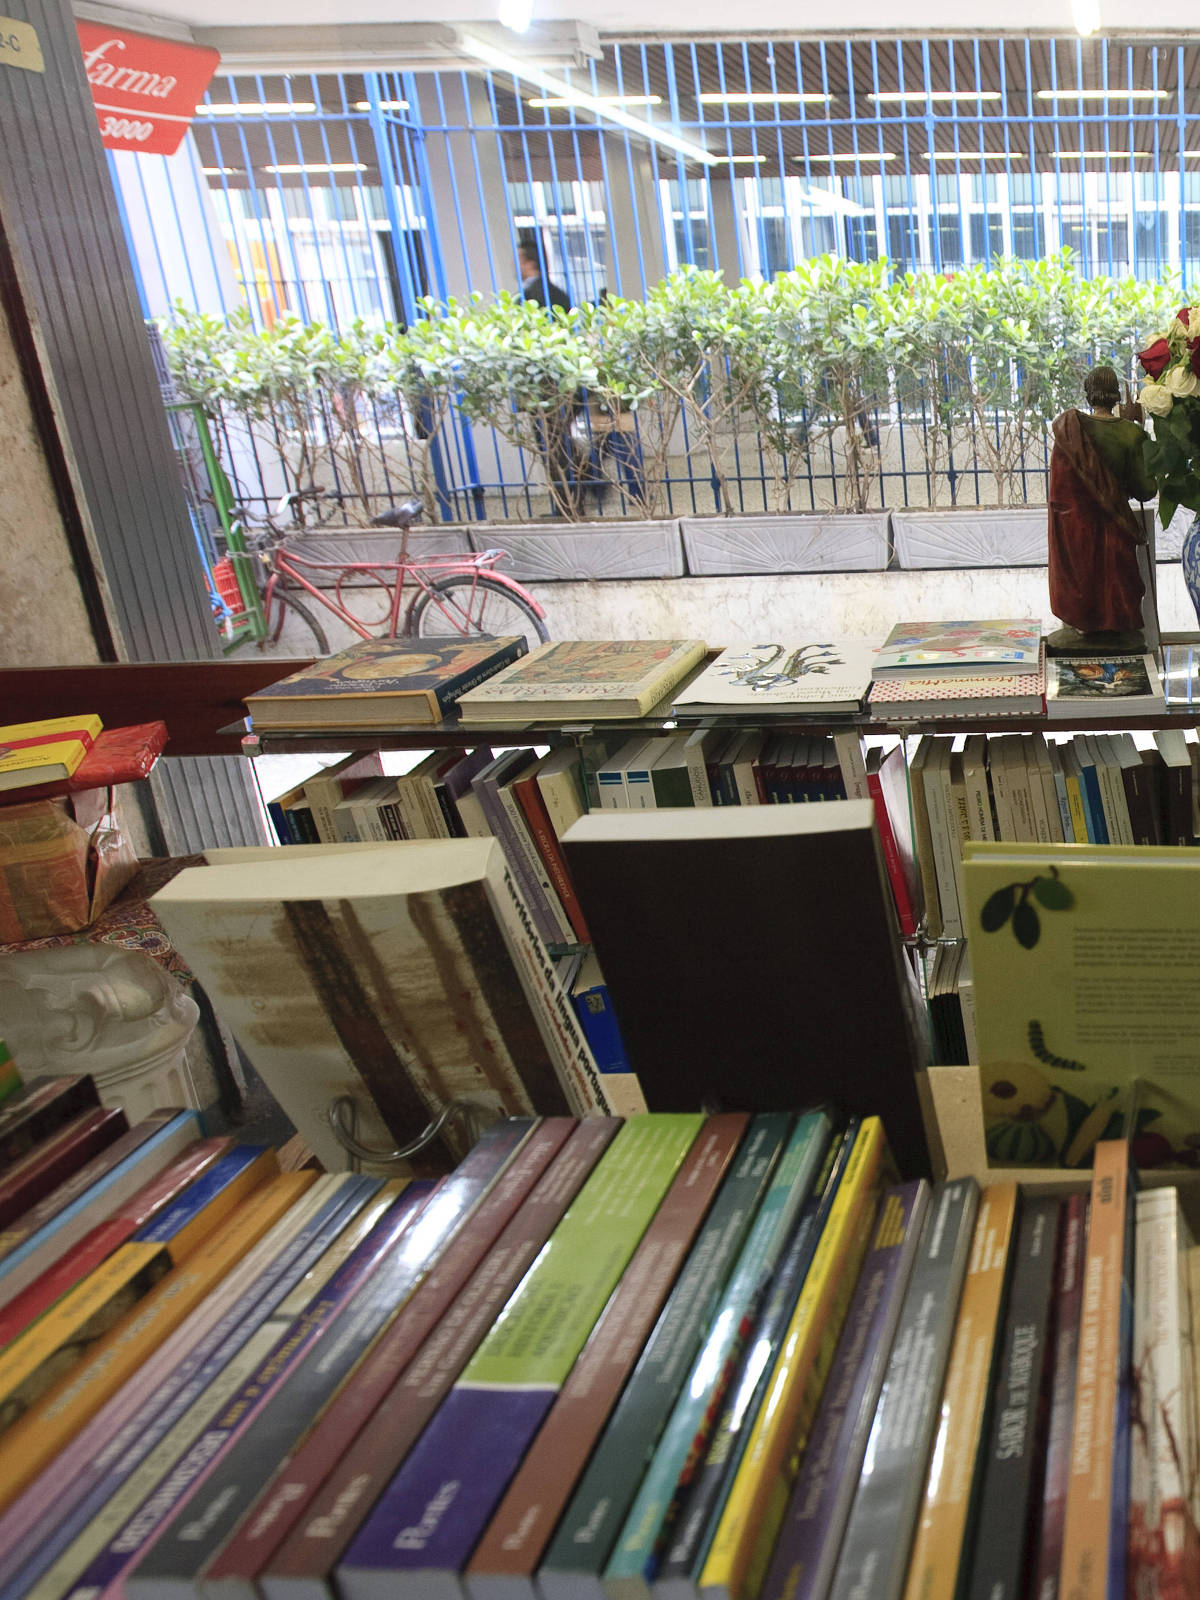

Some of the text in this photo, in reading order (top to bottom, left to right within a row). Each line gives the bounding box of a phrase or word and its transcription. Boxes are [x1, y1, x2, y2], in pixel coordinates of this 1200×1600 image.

[100, 116, 154, 141] 3000
[503, 864, 548, 972] Territórios
[543, 970, 556, 993] da
[555, 992, 580, 1048] língua
[1010, 1390, 1029, 1403] DE
[996, 1408, 1029, 1457] SABOR
[106, 1430, 233, 1552] DESCONHECIDO
[386, 1478, 468, 1550] Pontes
